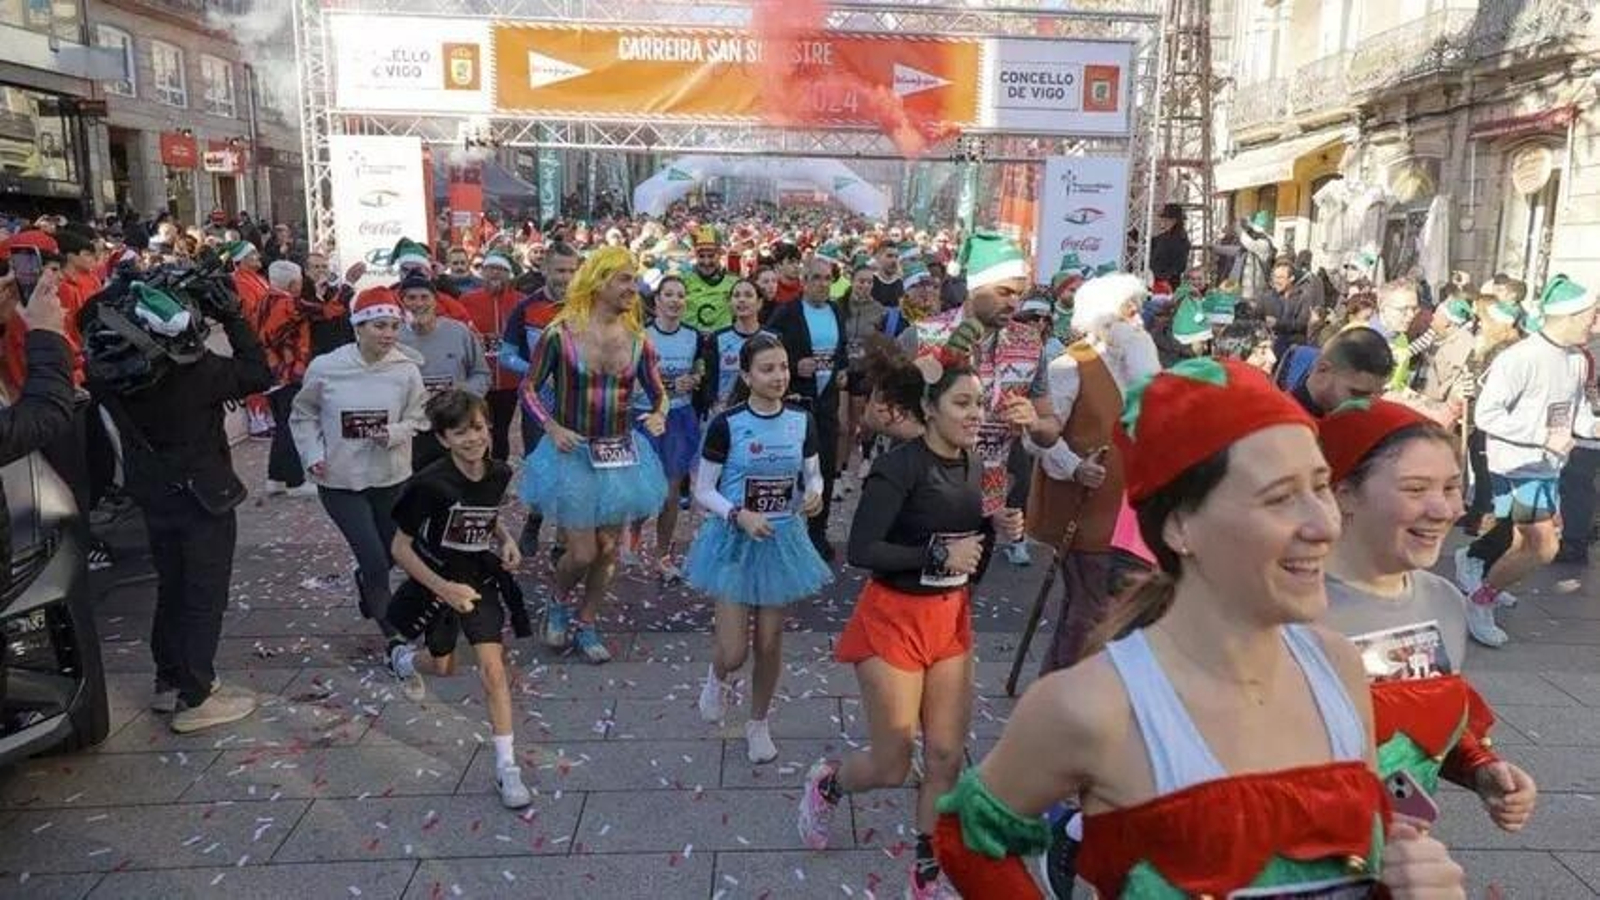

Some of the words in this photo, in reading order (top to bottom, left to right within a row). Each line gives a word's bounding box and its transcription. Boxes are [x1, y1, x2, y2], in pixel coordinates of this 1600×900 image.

[618, 37, 705, 62] CARREIRA
[707, 38, 741, 63] SAN
[746, 39, 834, 65] SISTRE
[385, 66, 422, 78] VIGO
[999, 70, 1074, 86] CONCELLO
[1008, 86, 1027, 98] DE
[1031, 87, 1065, 99] VIGO
[757, 496, 787, 511] 979
